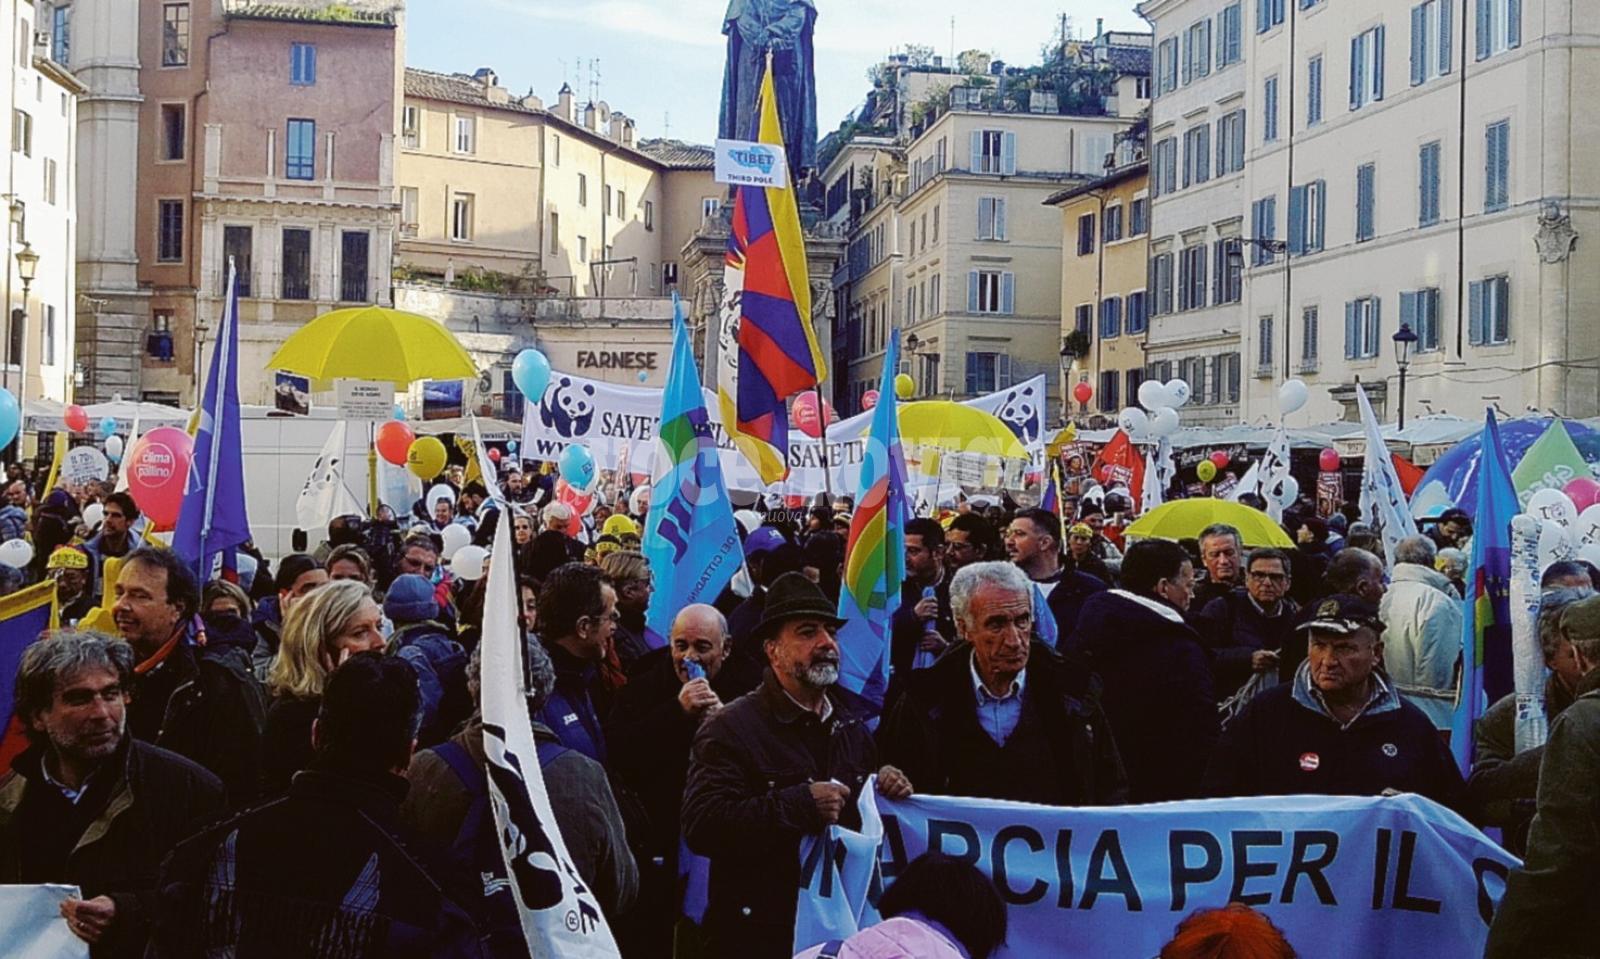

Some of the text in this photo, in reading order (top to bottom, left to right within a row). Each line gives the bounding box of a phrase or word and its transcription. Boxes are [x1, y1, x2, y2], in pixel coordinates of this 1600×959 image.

[734, 151, 773, 165] TIBET
[728, 174, 773, 184] THIRD POLE
[577, 350, 658, 369] FARNESE
[601, 412, 651, 441] SAVE
[142, 451, 170, 464] clima
[790, 441, 842, 469] SAVE
[138, 466, 169, 478] pallino
[1169, 829, 1339, 909] PER
[1371, 828, 1442, 916] IL
